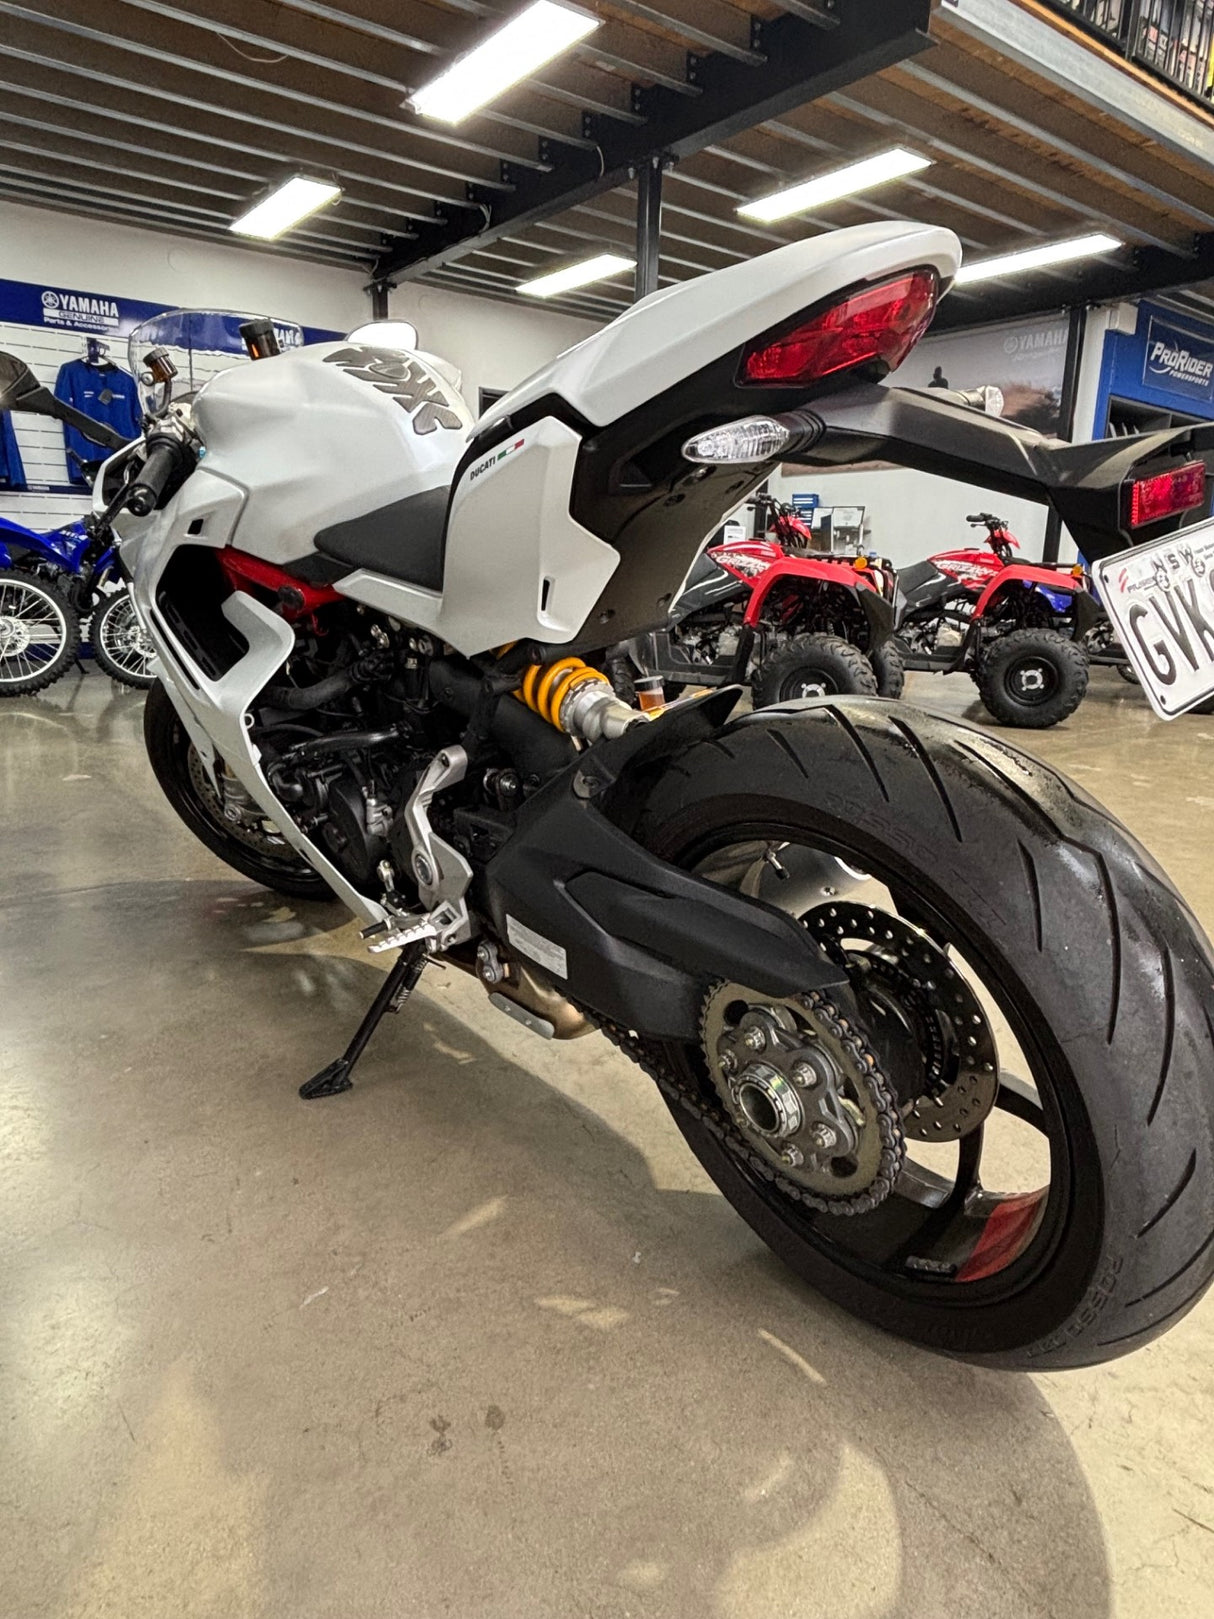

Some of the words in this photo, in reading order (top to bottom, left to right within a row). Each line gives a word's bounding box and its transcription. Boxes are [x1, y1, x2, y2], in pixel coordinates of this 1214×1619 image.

[59, 294, 119, 317] YAMAHA
[43, 316, 65, 325] Parts
[58, 311, 104, 323] GENUINE
[1169, 369, 1210, 387] POWERSPORTS
[470, 456, 496, 480] DUCATI
